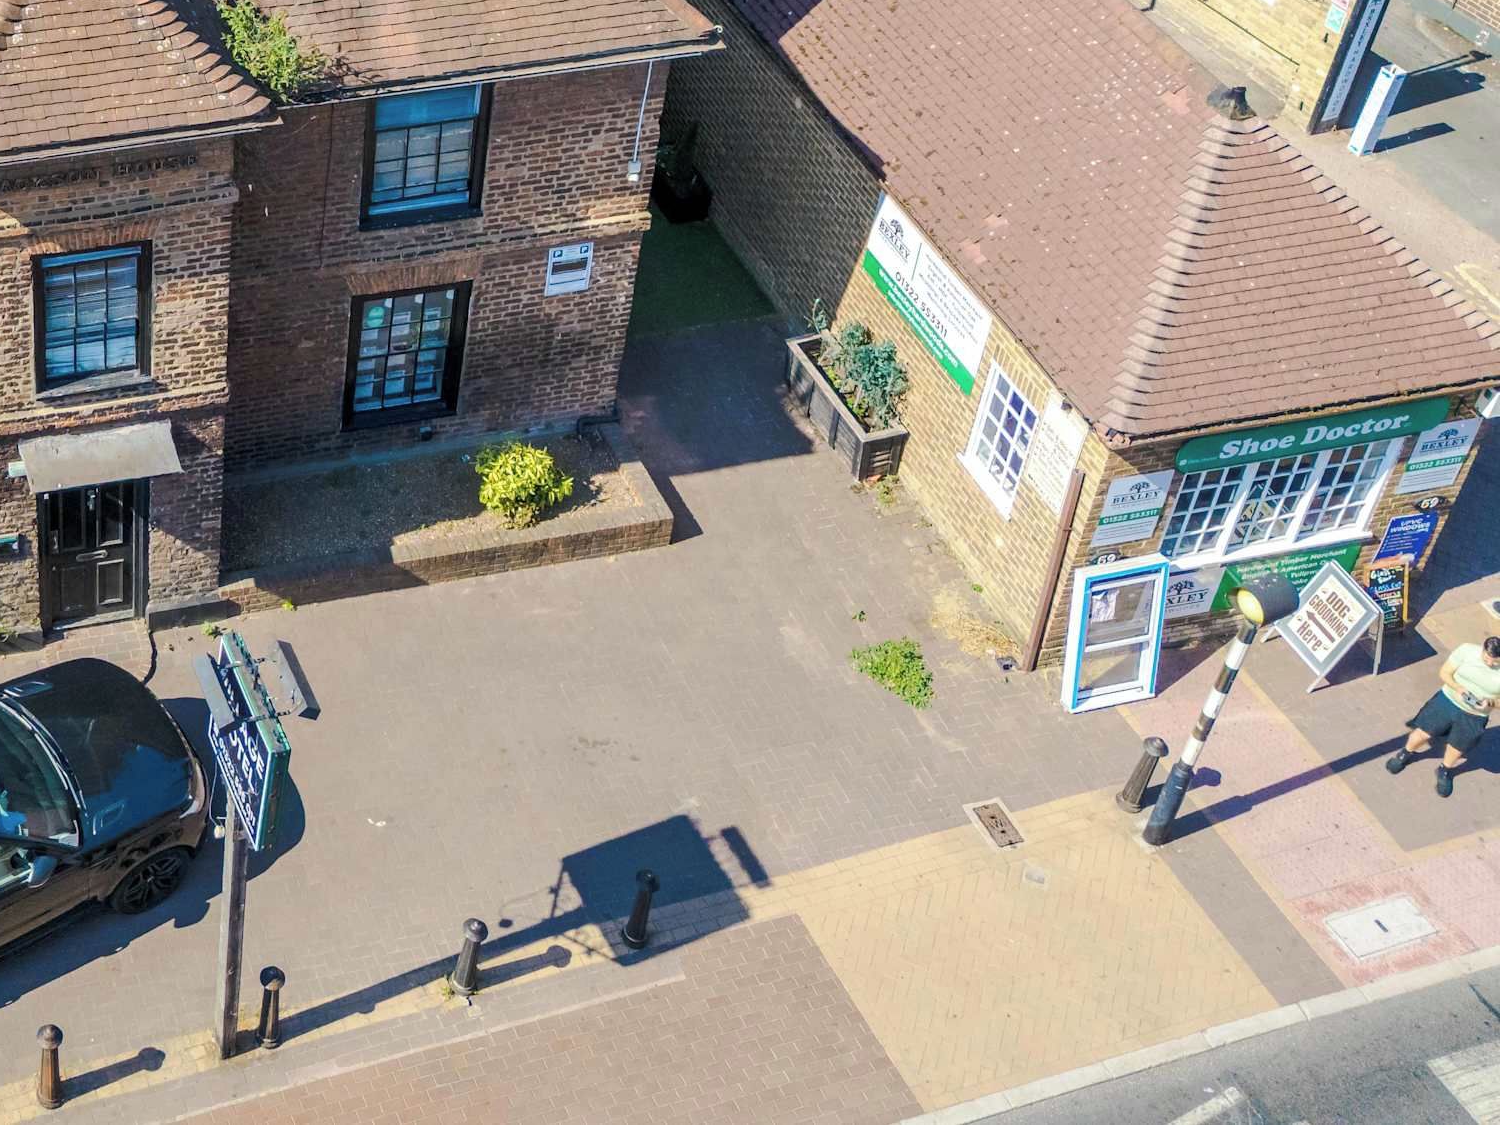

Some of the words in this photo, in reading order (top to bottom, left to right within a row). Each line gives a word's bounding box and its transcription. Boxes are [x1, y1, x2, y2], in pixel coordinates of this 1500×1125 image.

[879, 218, 910, 259] BEXLEY
[894, 270, 919, 304] 01322
[919, 300, 947, 339] 553311
[1219, 434, 1296, 459] Shoe
[1300, 414, 1409, 445] Doctor
[1420, 436, 1468, 451] BEXLEY
[1111, 490, 1161, 504] BEXLEY
[1421, 496, 1439, 509] 69
[1103, 513, 1128, 524] 01322
[1308, 594, 1349, 639] GROOMING
[1326, 591, 1351, 619] DOG
[1296, 620, 1323, 652] Here
